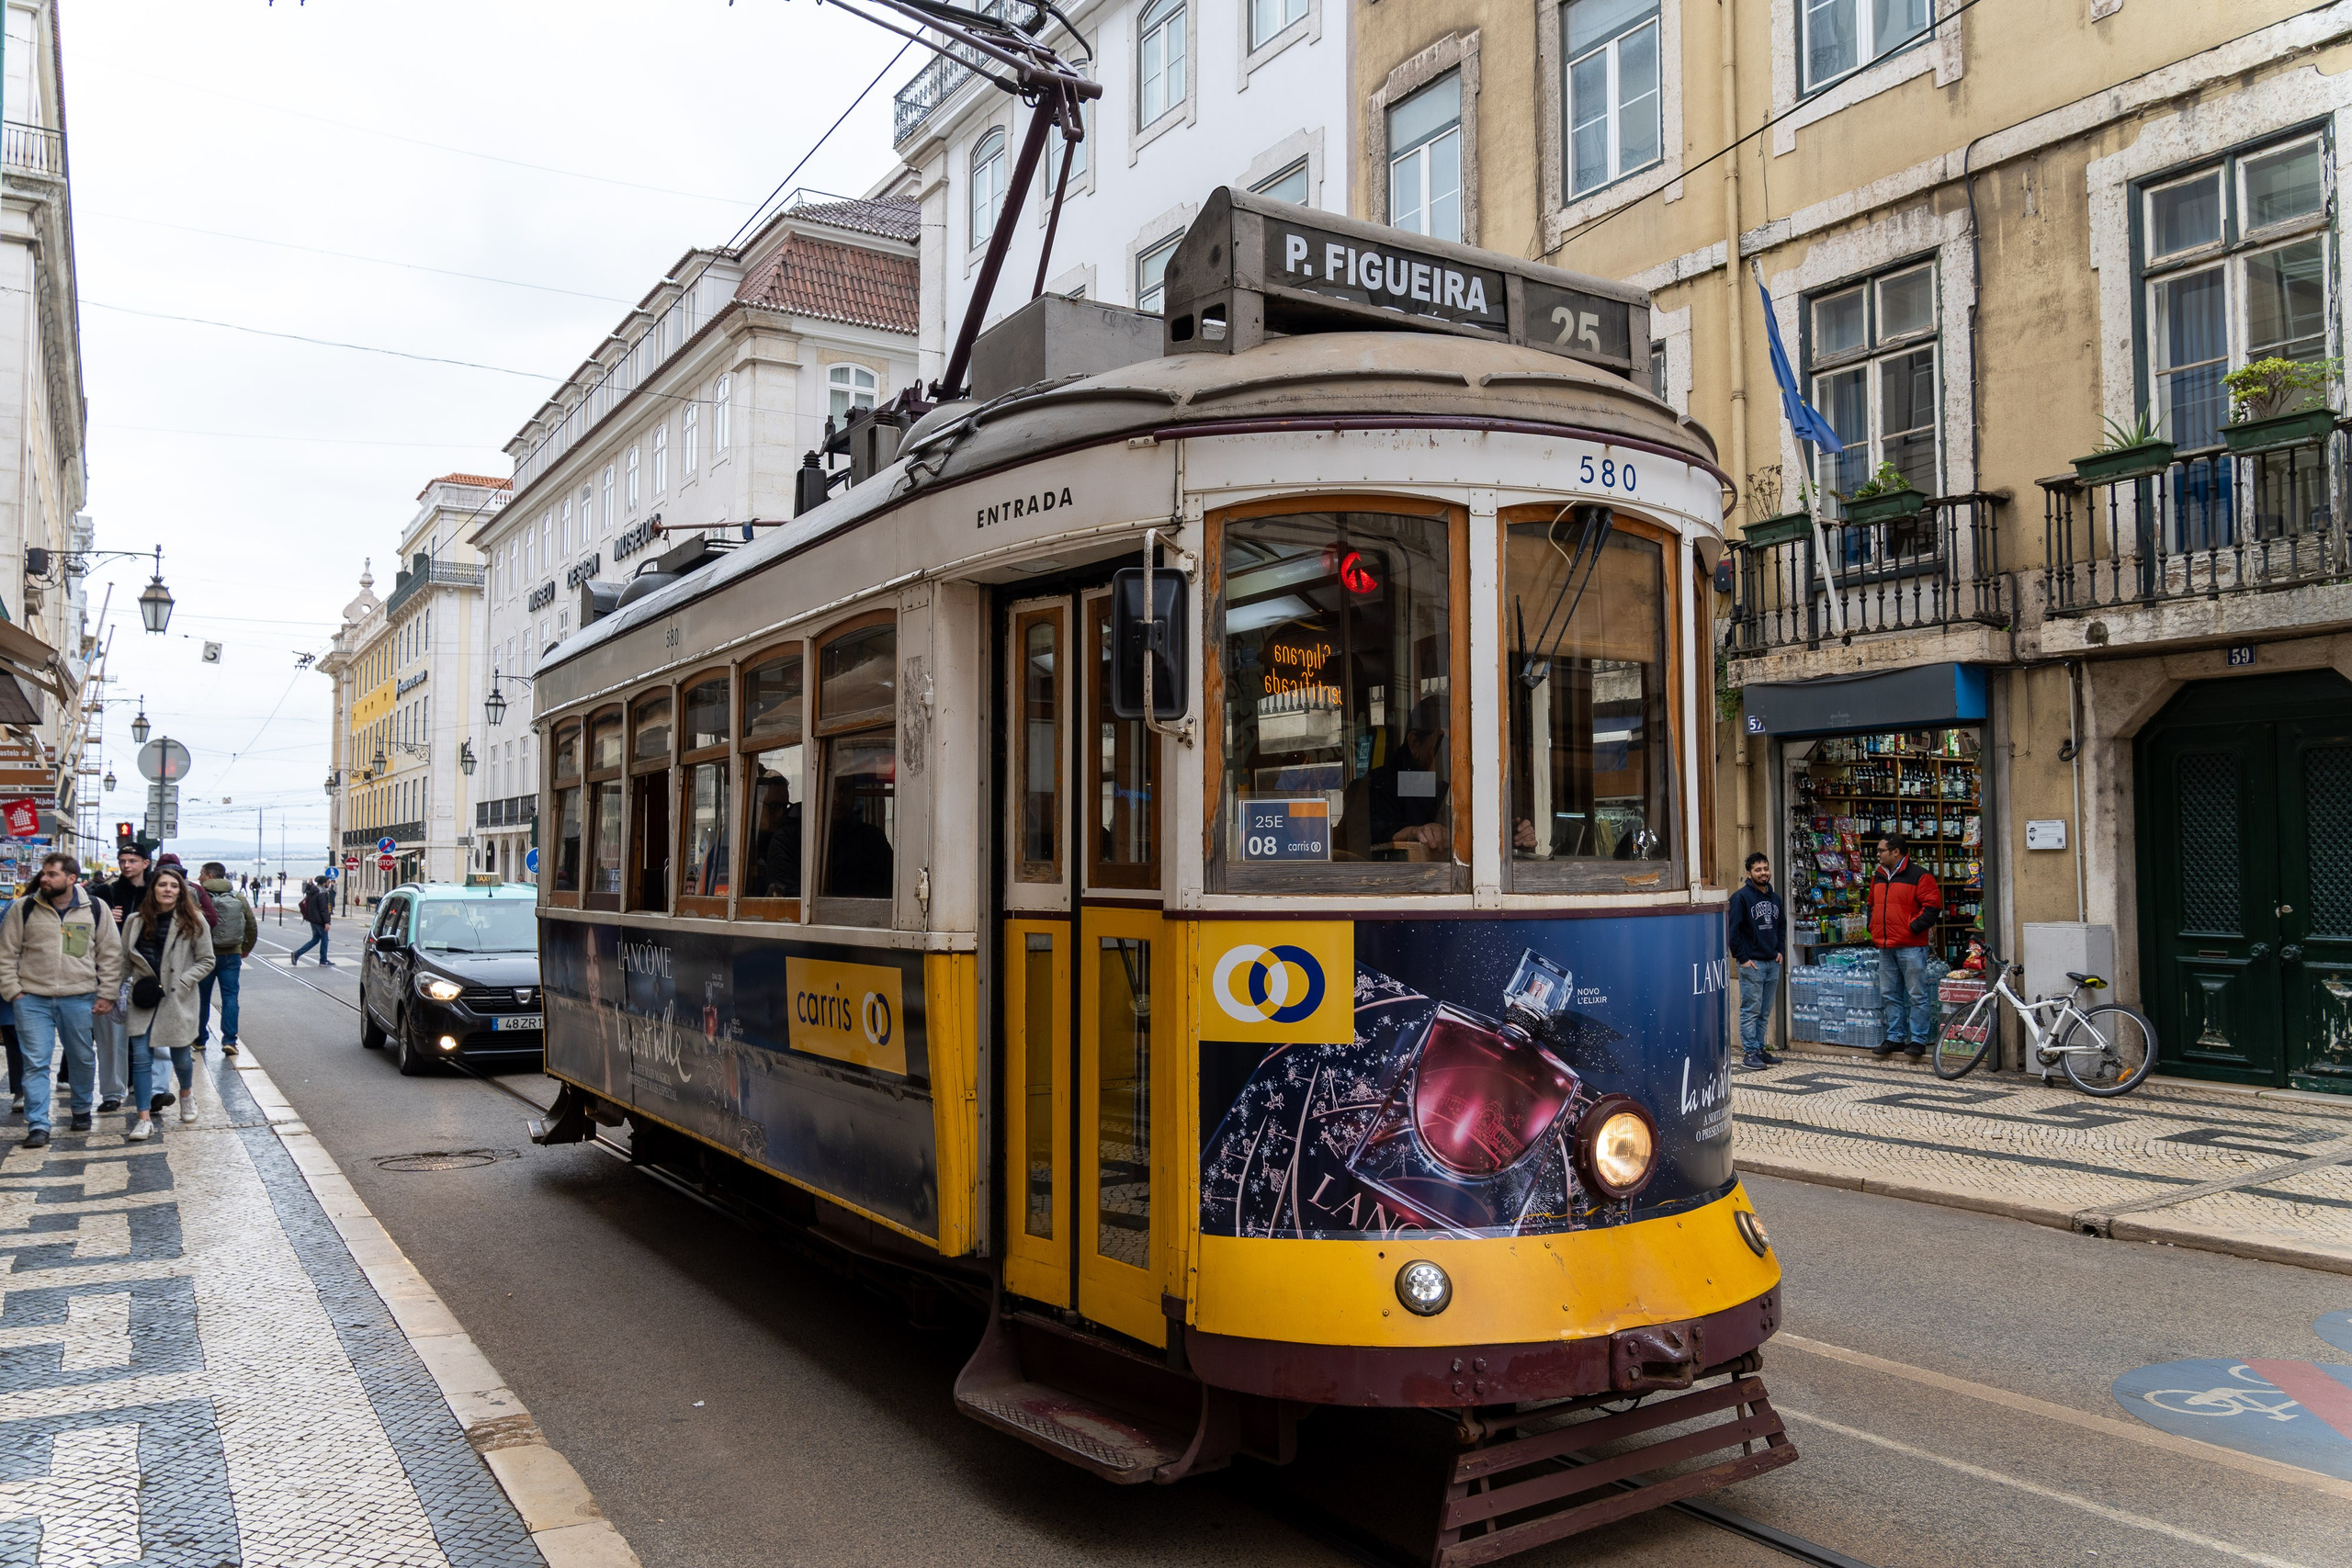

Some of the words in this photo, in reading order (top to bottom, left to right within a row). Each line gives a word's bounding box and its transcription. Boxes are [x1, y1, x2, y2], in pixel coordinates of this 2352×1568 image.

[1286, 234, 1312, 276] P.
[1325, 243, 1488, 315] FIGUEIRA
[1551, 306, 1600, 355] 25
[1579, 455, 1637, 491] 580
[977, 487, 1073, 529] ENTRADA
[528, 581, 555, 613] MUSEU
[567, 553, 600, 590] DESIGN
[665, 627, 679, 649] 580
[2232, 647, 2250, 664] 59
[1749, 718, 1763, 731] 57
[1255, 815, 1283, 829] 25E
[1248, 836, 1278, 856] 08
[1287, 840, 1310, 852] carris
[475, 874, 492, 883] TAXI
[616, 938, 673, 979] LANCÔME
[1577, 987, 1600, 996] NOVO
[1577, 996, 1608, 1005] L'ELIXIR
[797, 982, 853, 1032] carris
